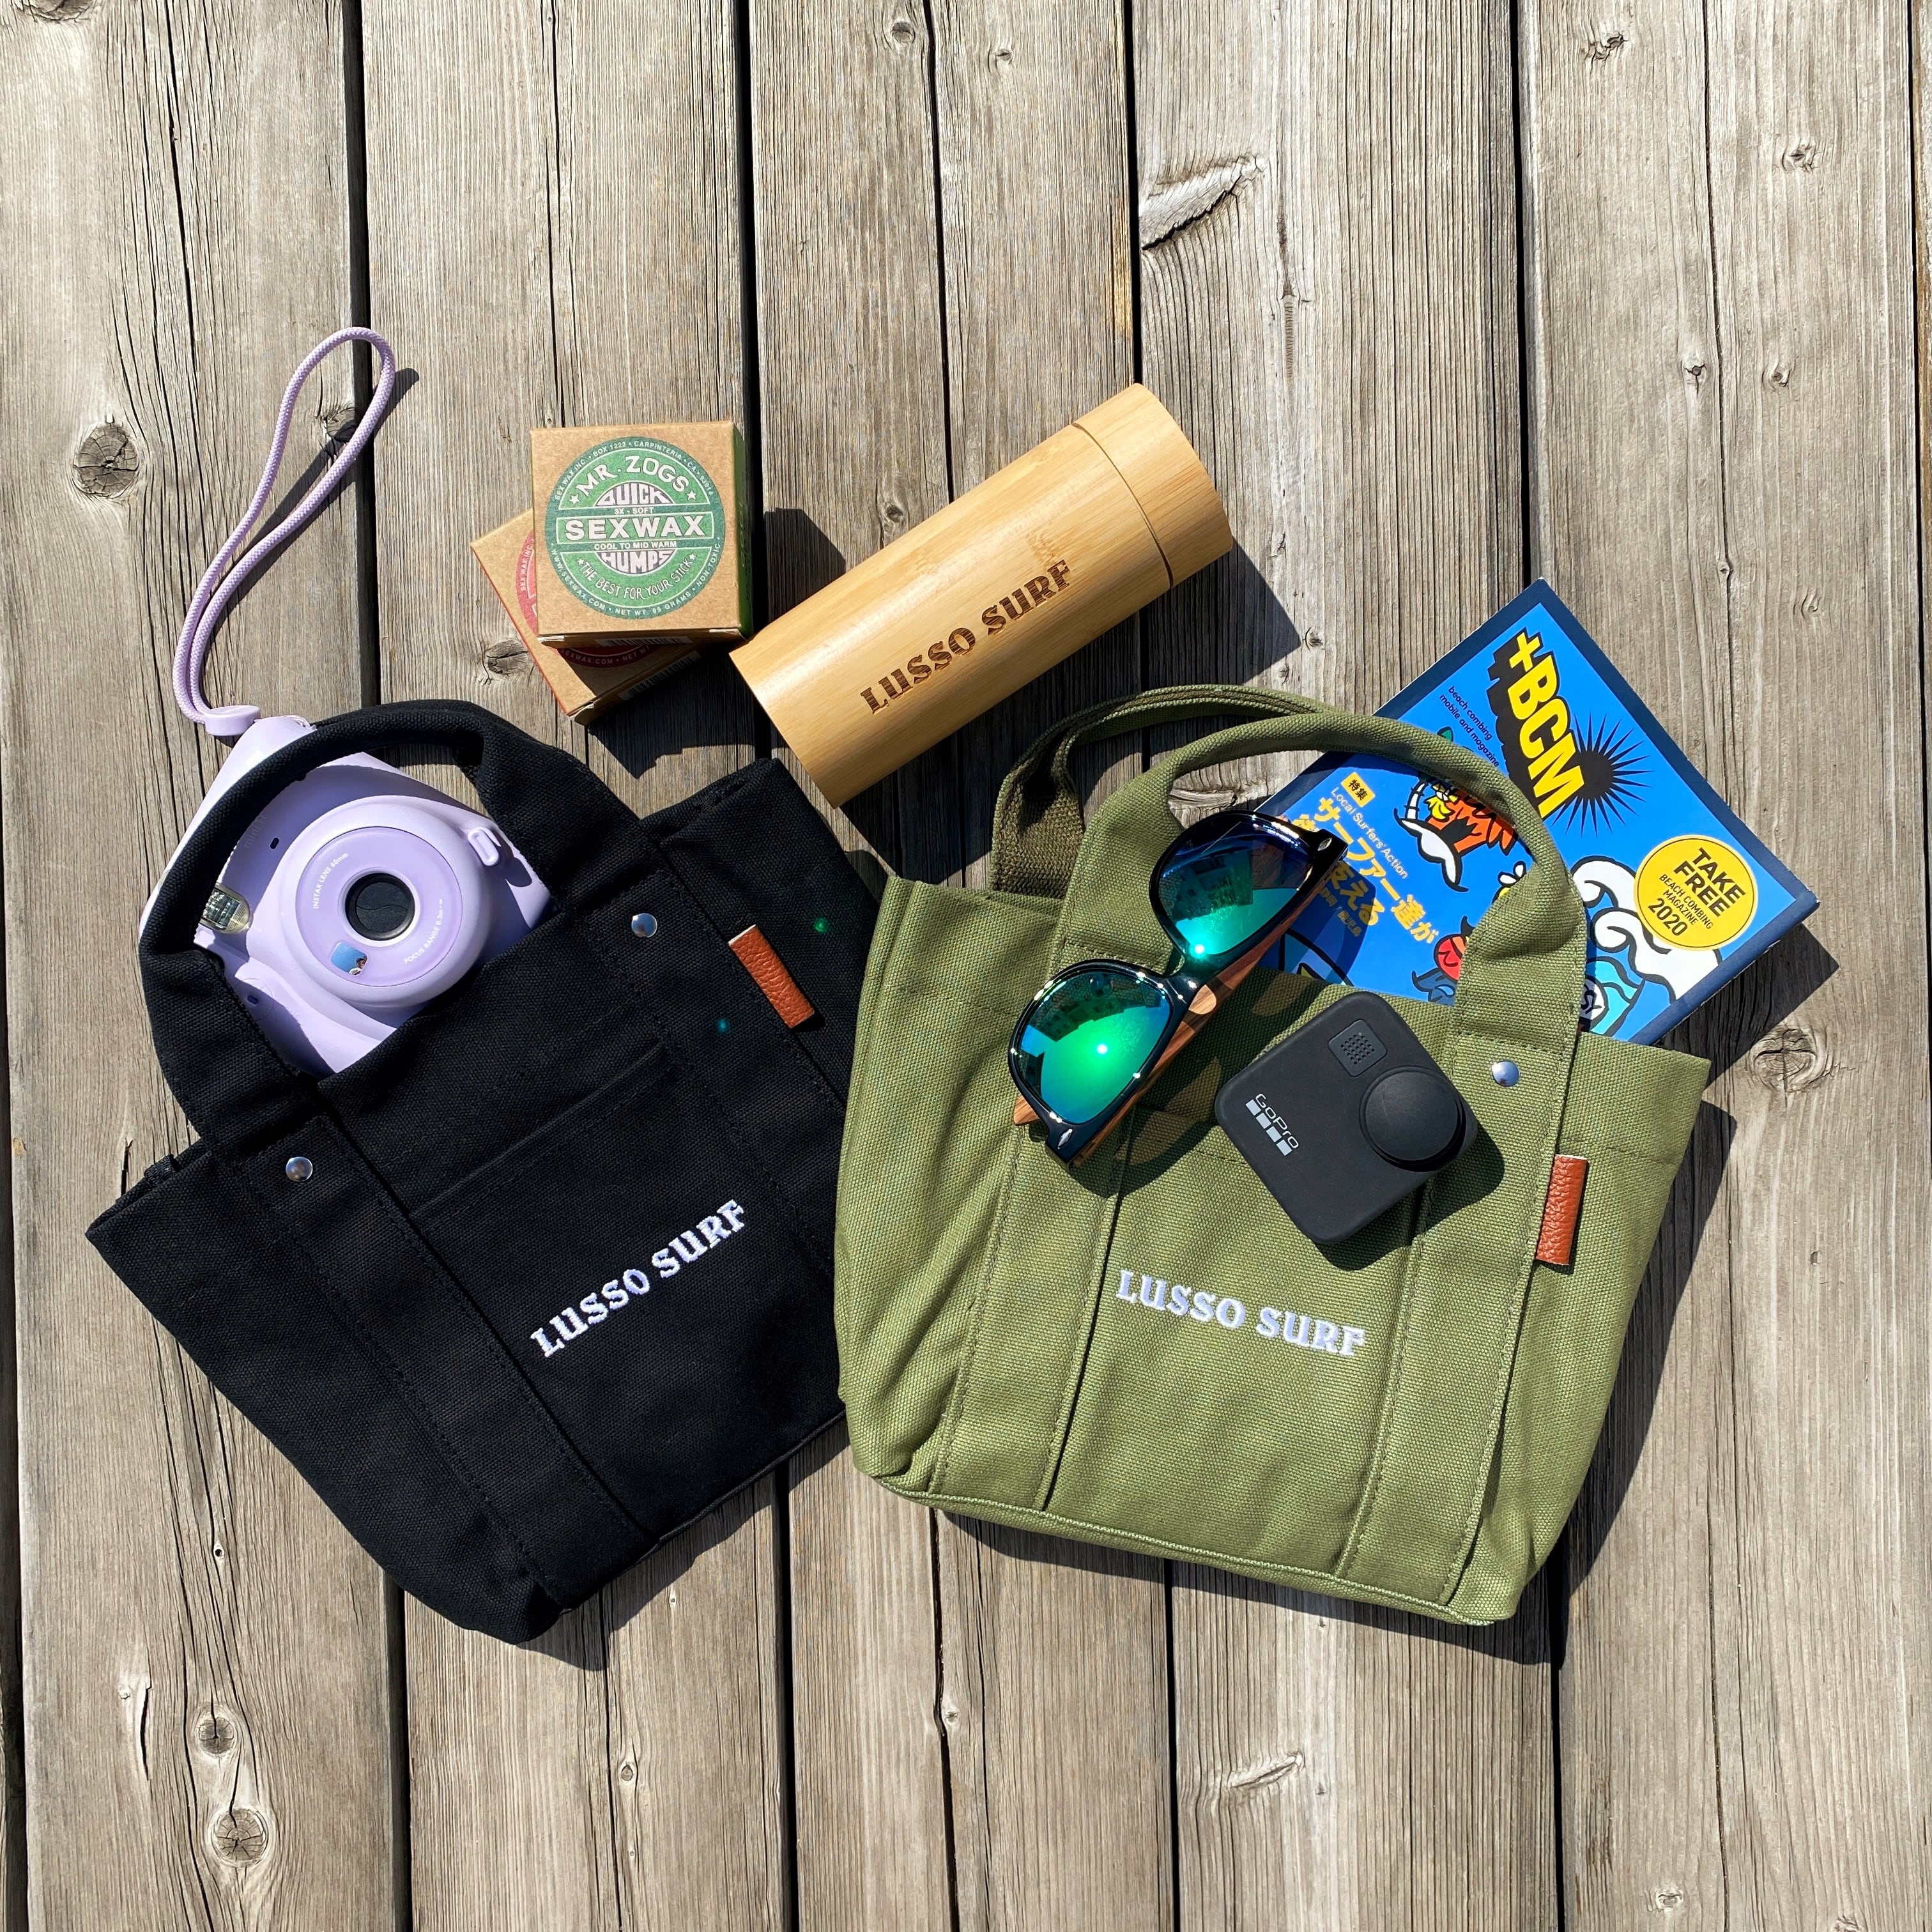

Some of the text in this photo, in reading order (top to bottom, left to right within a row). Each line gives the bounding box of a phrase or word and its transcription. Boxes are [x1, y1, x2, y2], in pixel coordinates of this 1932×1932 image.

[555, 484, 565, 500] SEX
[561, 471, 576, 486] WAX
[592, 445, 608, 457] BOX
[634, 440, 682, 461] CARPINTERIA
[595, 481, 672, 507] QUICK
[625, 454, 690, 493] ZOGS
[565, 515, 705, 540] SEXWAX
[579, 558, 693, 600] THE BEST FOR YOUR STICK
[601, 550, 673, 573] HUMPS
[664, 591, 692, 610] GRAMS
[696, 542, 721, 586] NON-TOXIC
[860, 559, 1070, 715] LUSSO SURF
[1439, 694, 1500, 767] mobile and magazine
[1448, 686, 1493, 741] beach combing
[1348, 779, 1368, 801] 特集
[1331, 786, 1358, 815] Local
[1380, 848, 1408, 879] Action
[313, 884, 322, 909] INSTAX
[319, 867, 332, 883] LENS
[1314, 797, 1439, 944] サーファー達が
[1674, 861, 1731, 917] FREE
[1692, 847, 1746, 904] TAKE
[1648, 898, 1688, 936] 2020
[1659, 874, 1713, 929] BEACH COMBING
[1663, 889, 1698, 926] MAGAZINE
[1255, 1093, 1300, 1149] GoPro
[530, 1199, 745, 1358] LUSSO SURF
[1116, 1269, 1365, 1356] LUSSO SURF
